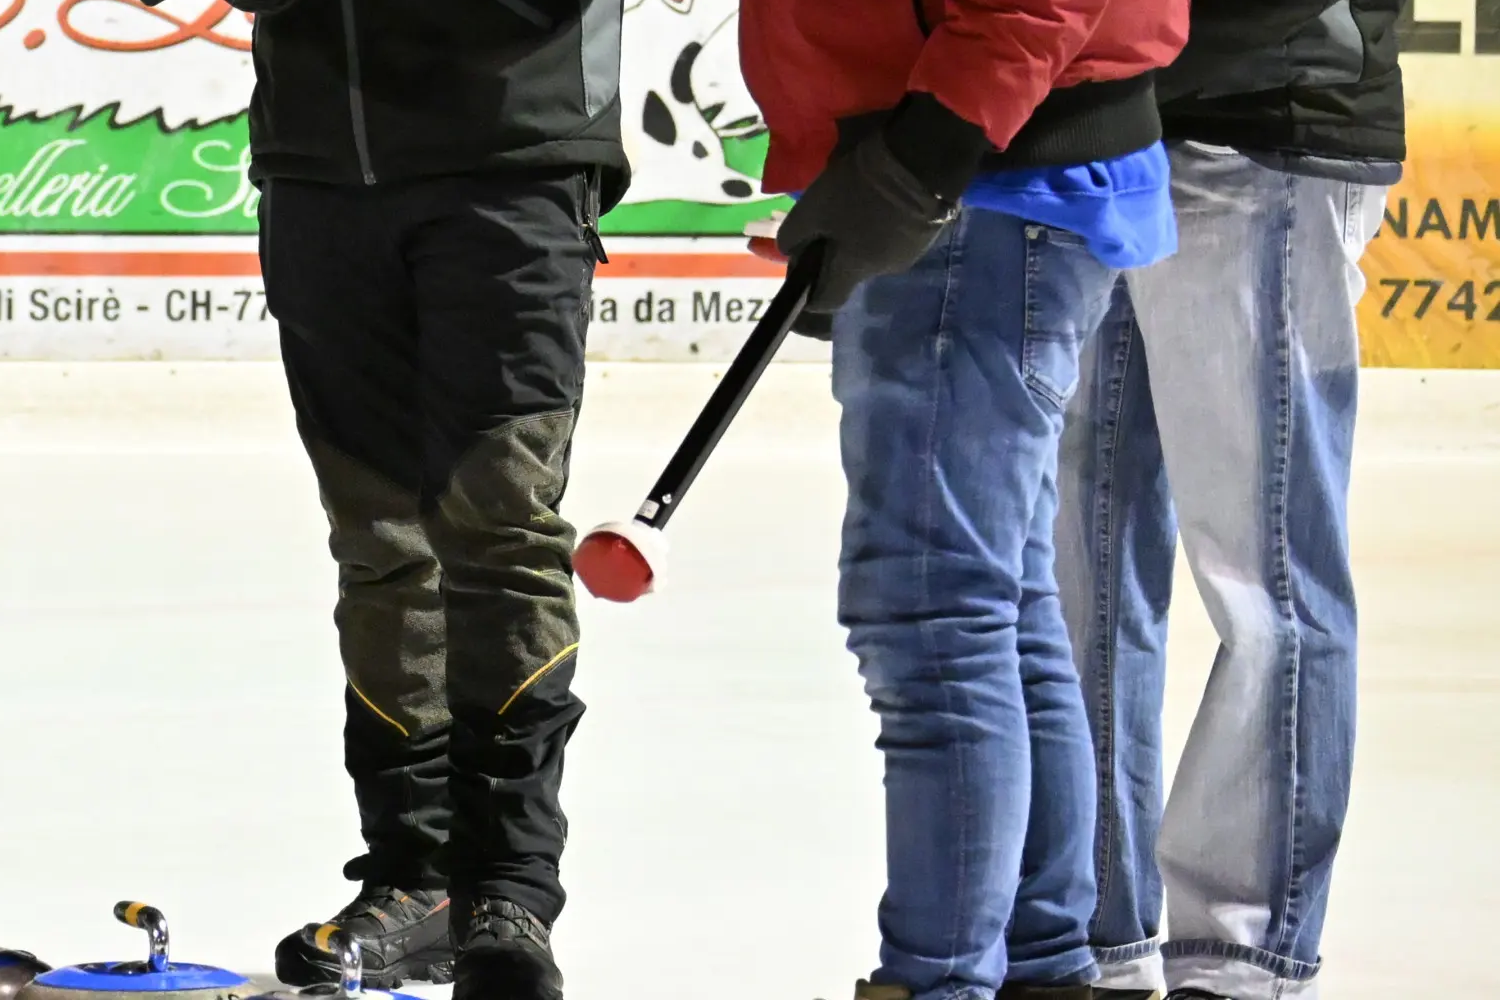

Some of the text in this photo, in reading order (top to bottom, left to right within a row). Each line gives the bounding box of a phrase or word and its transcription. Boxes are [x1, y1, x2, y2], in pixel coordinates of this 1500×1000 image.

[29, 288, 121, 322] Scirè
[634, 291, 676, 323] da
[692, 291, 773, 323] Mez
